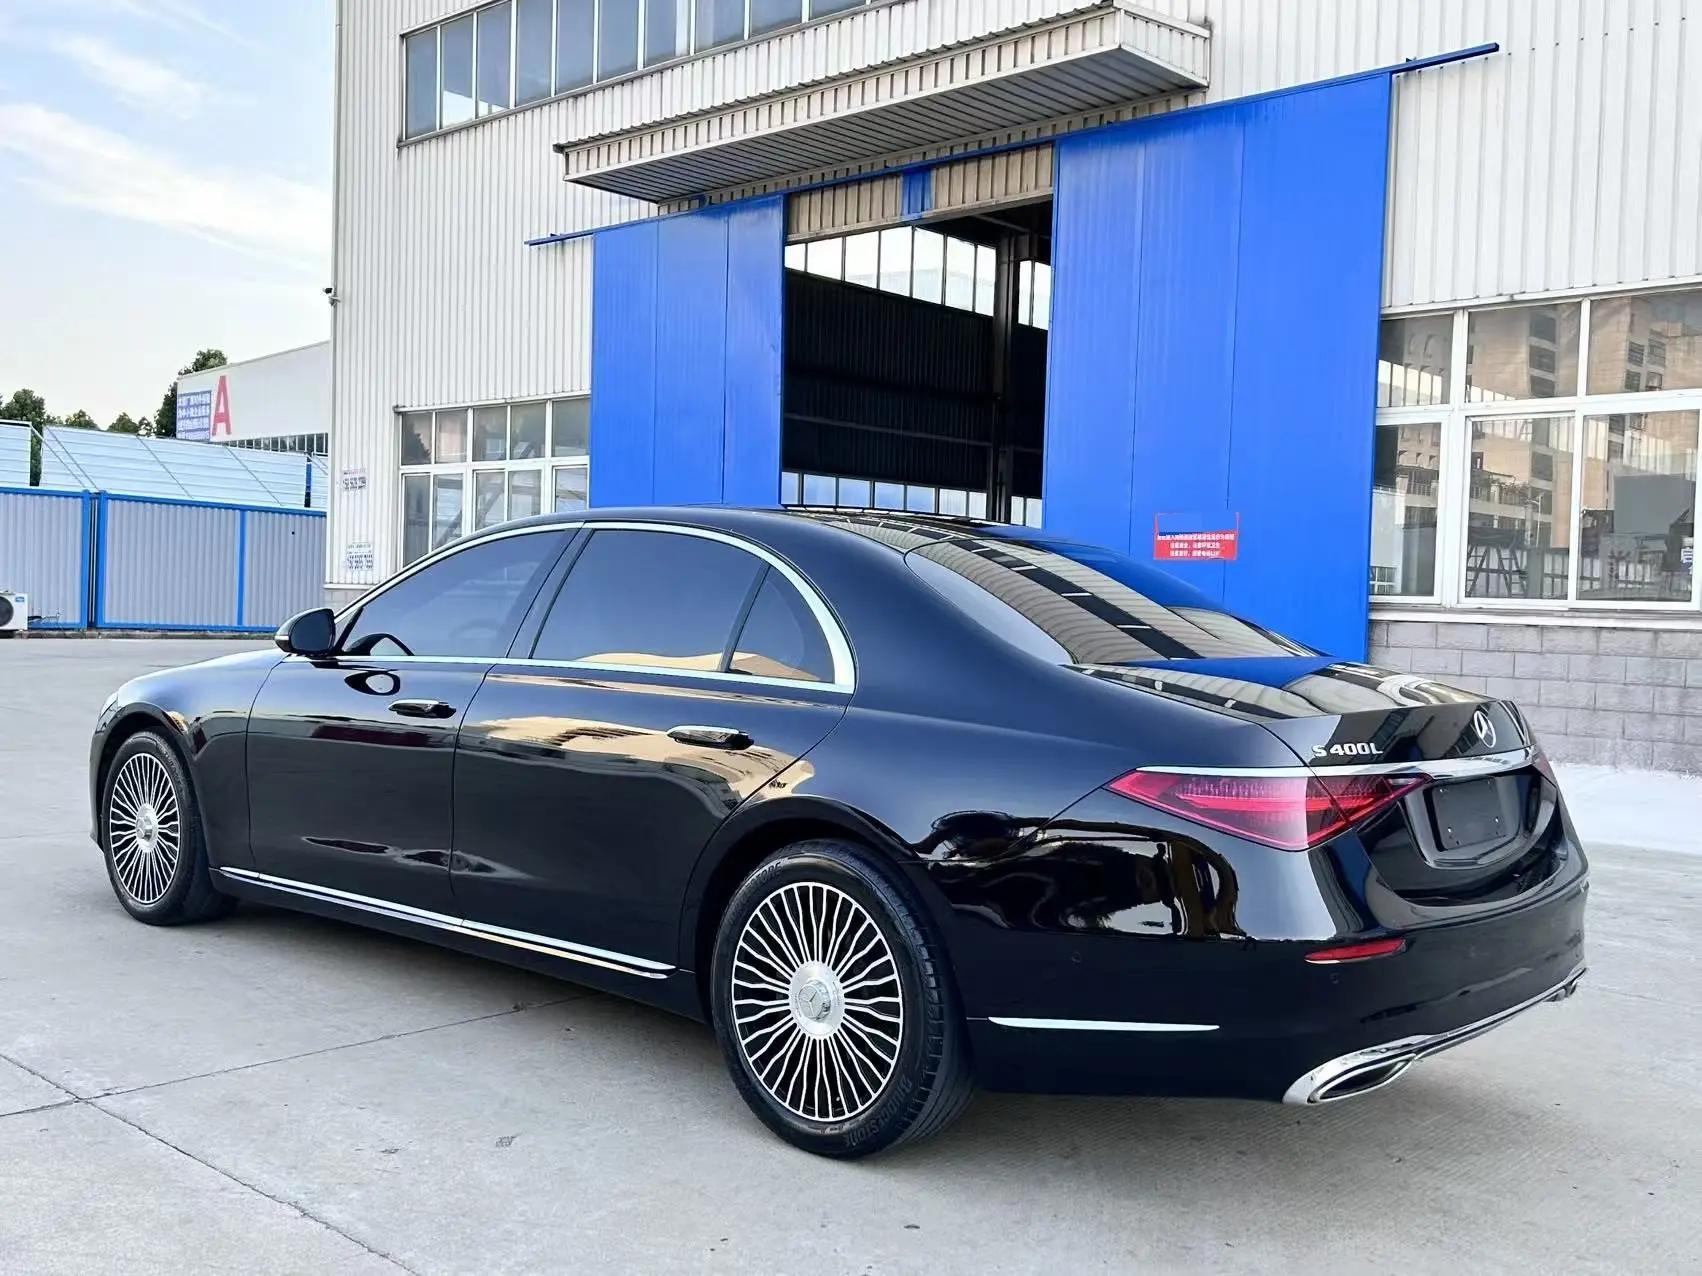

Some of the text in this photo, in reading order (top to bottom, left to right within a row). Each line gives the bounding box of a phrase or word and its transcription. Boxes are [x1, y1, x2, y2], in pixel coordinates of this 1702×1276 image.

[212, 375, 231, 436] A
[1312, 742, 1384, 757] S 400L
